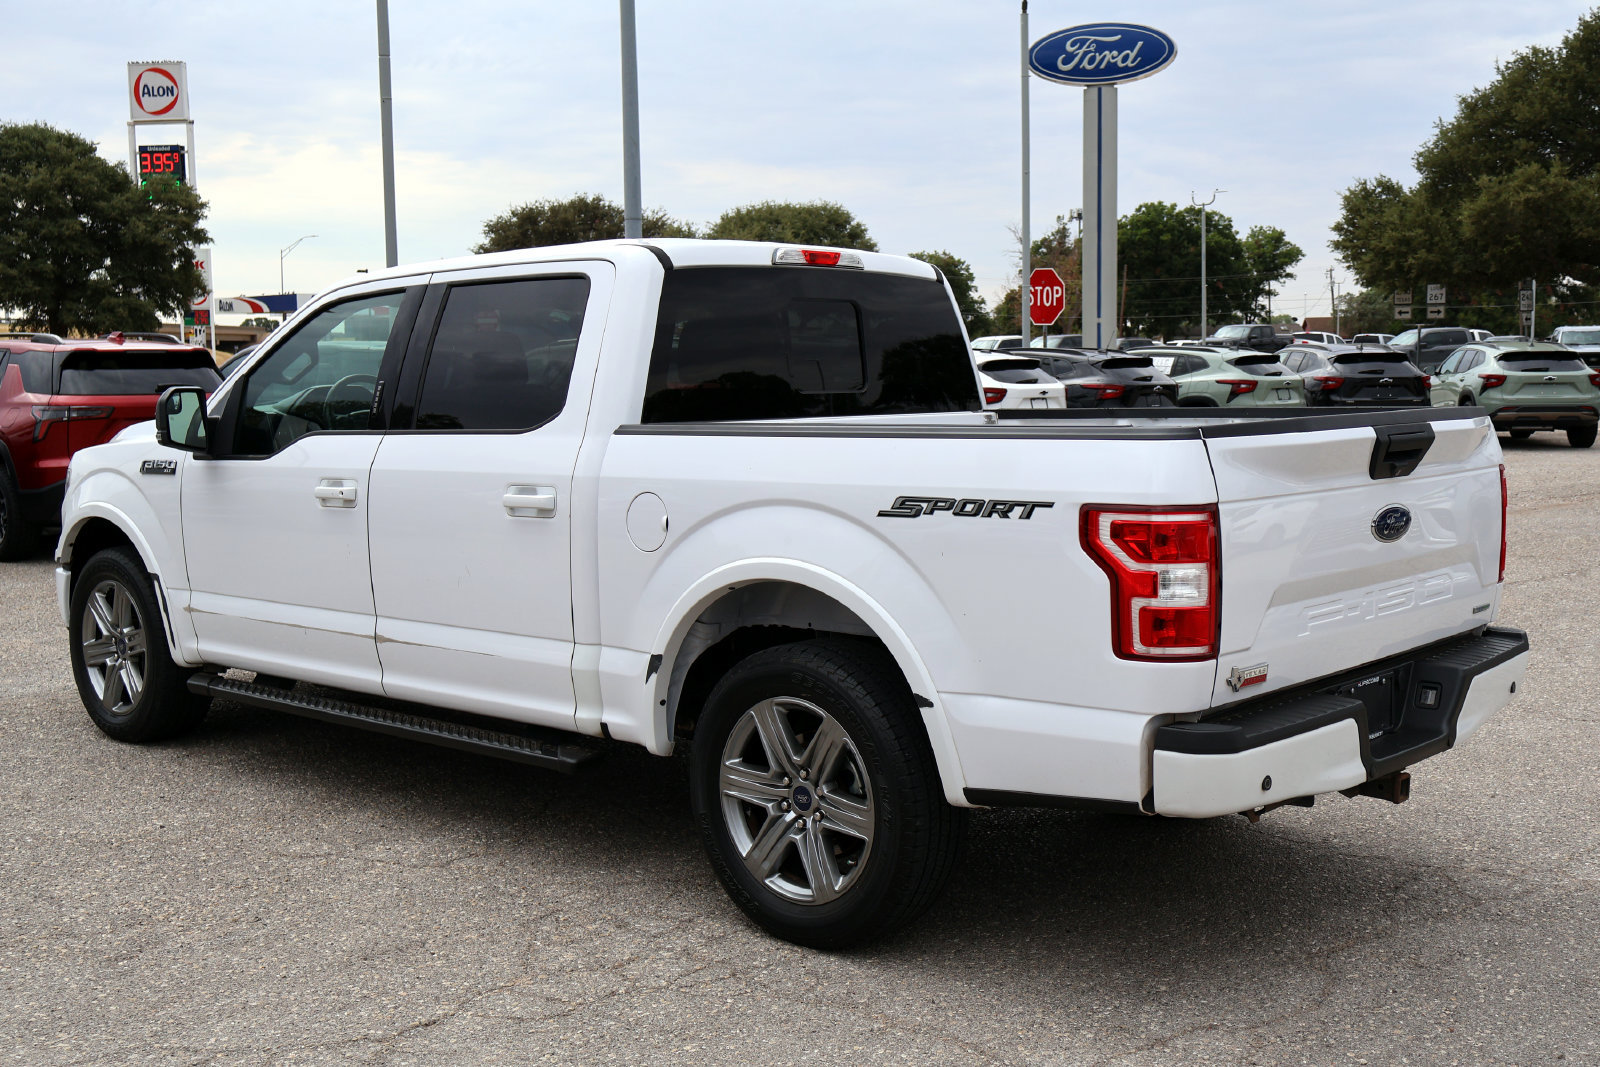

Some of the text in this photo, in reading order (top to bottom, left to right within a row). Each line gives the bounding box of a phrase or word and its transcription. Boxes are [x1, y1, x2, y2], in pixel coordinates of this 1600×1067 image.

[1056, 34, 1144, 72] Ford
[142, 84, 175, 98] ALON
[1030, 286, 1062, 307] STOP
[1429, 293, 1444, 301] 267
[876, 496, 1056, 520] SPORT
[1245, 667, 1267, 678] TEXAS
